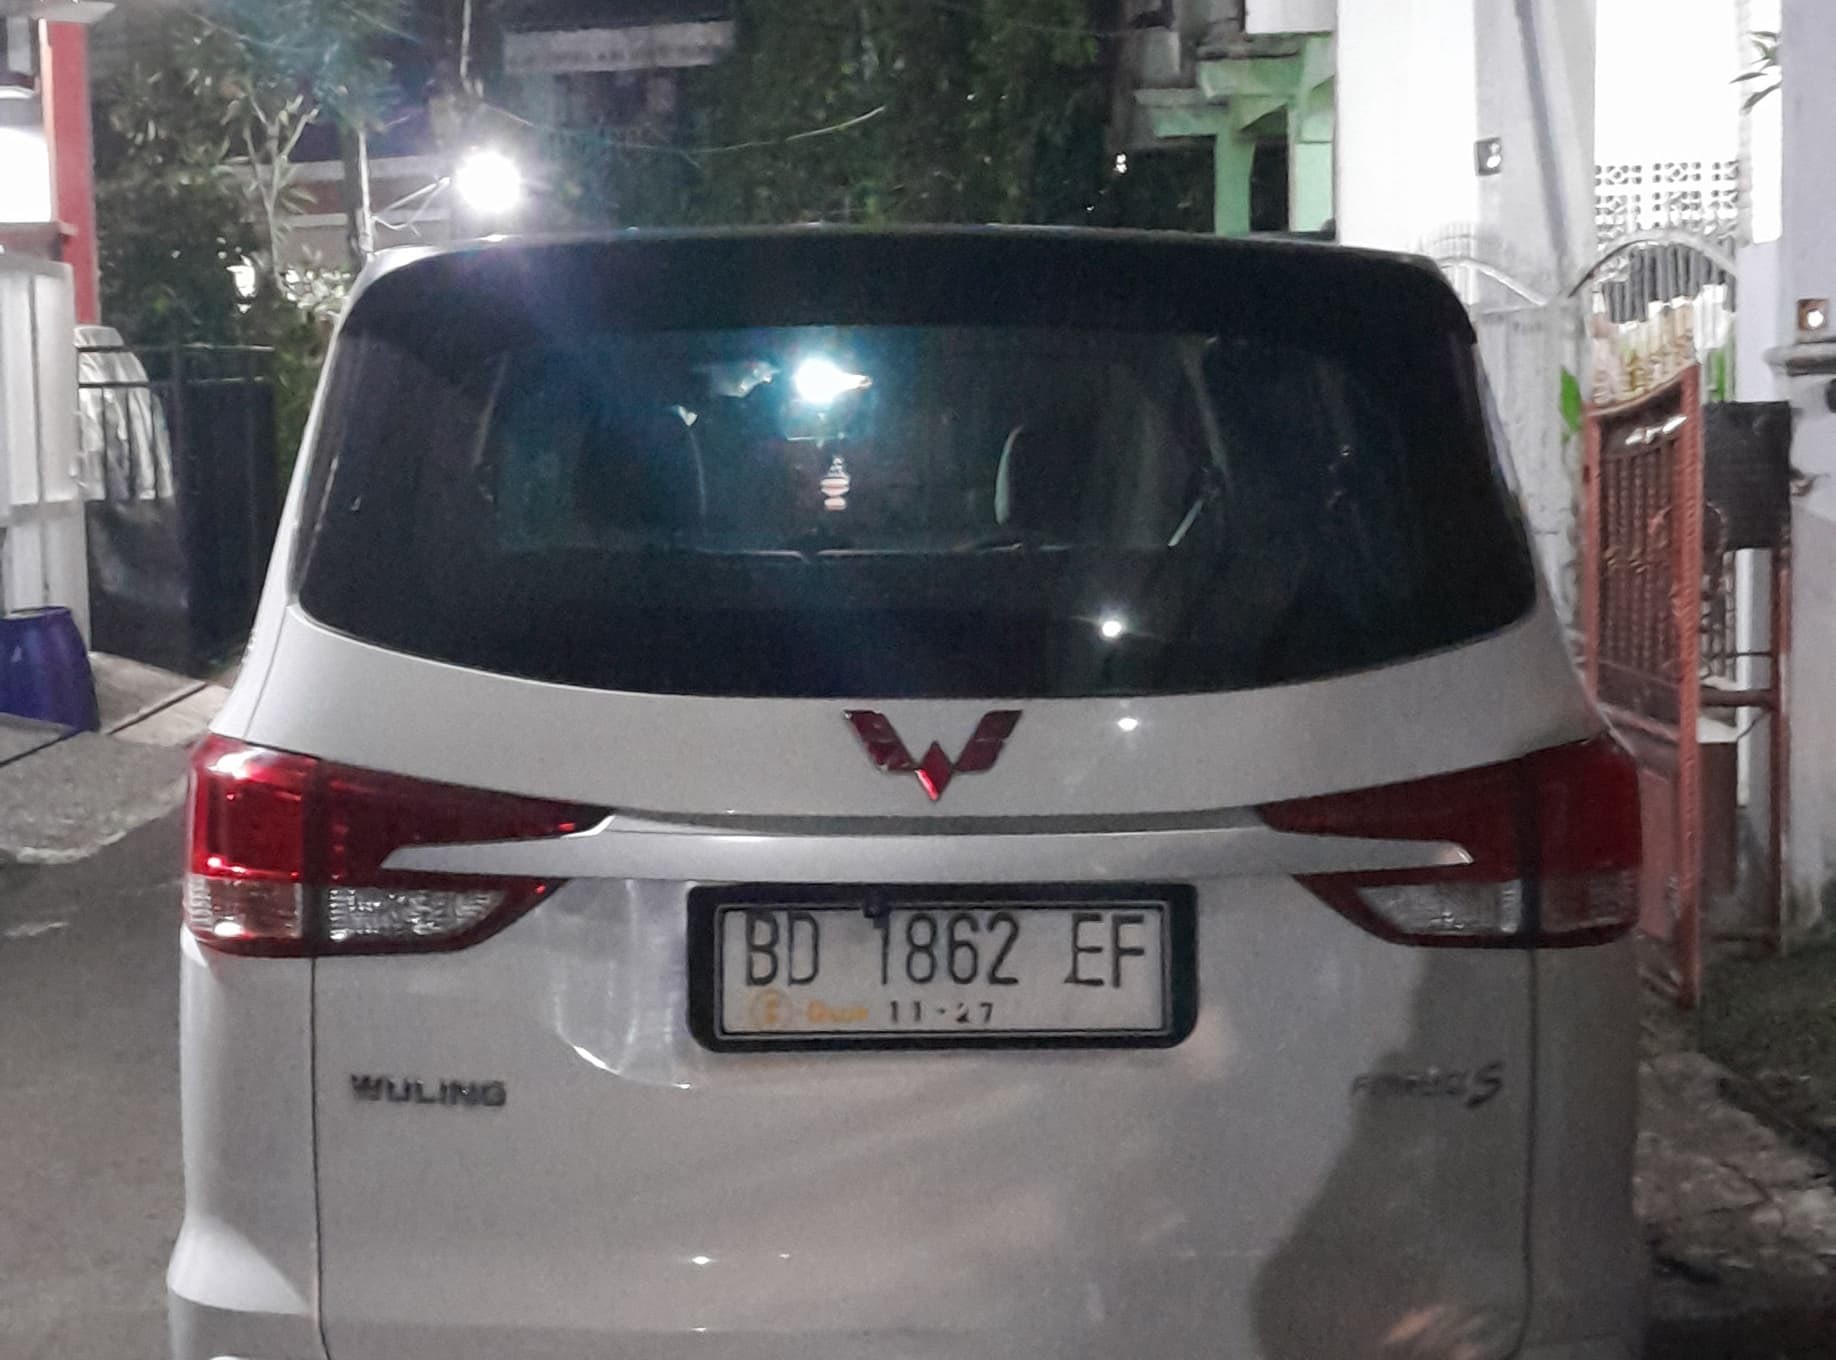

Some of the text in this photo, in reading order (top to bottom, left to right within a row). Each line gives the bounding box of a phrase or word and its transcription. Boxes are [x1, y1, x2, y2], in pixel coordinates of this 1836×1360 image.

[745, 911, 1146, 988] BD 1862 EF
